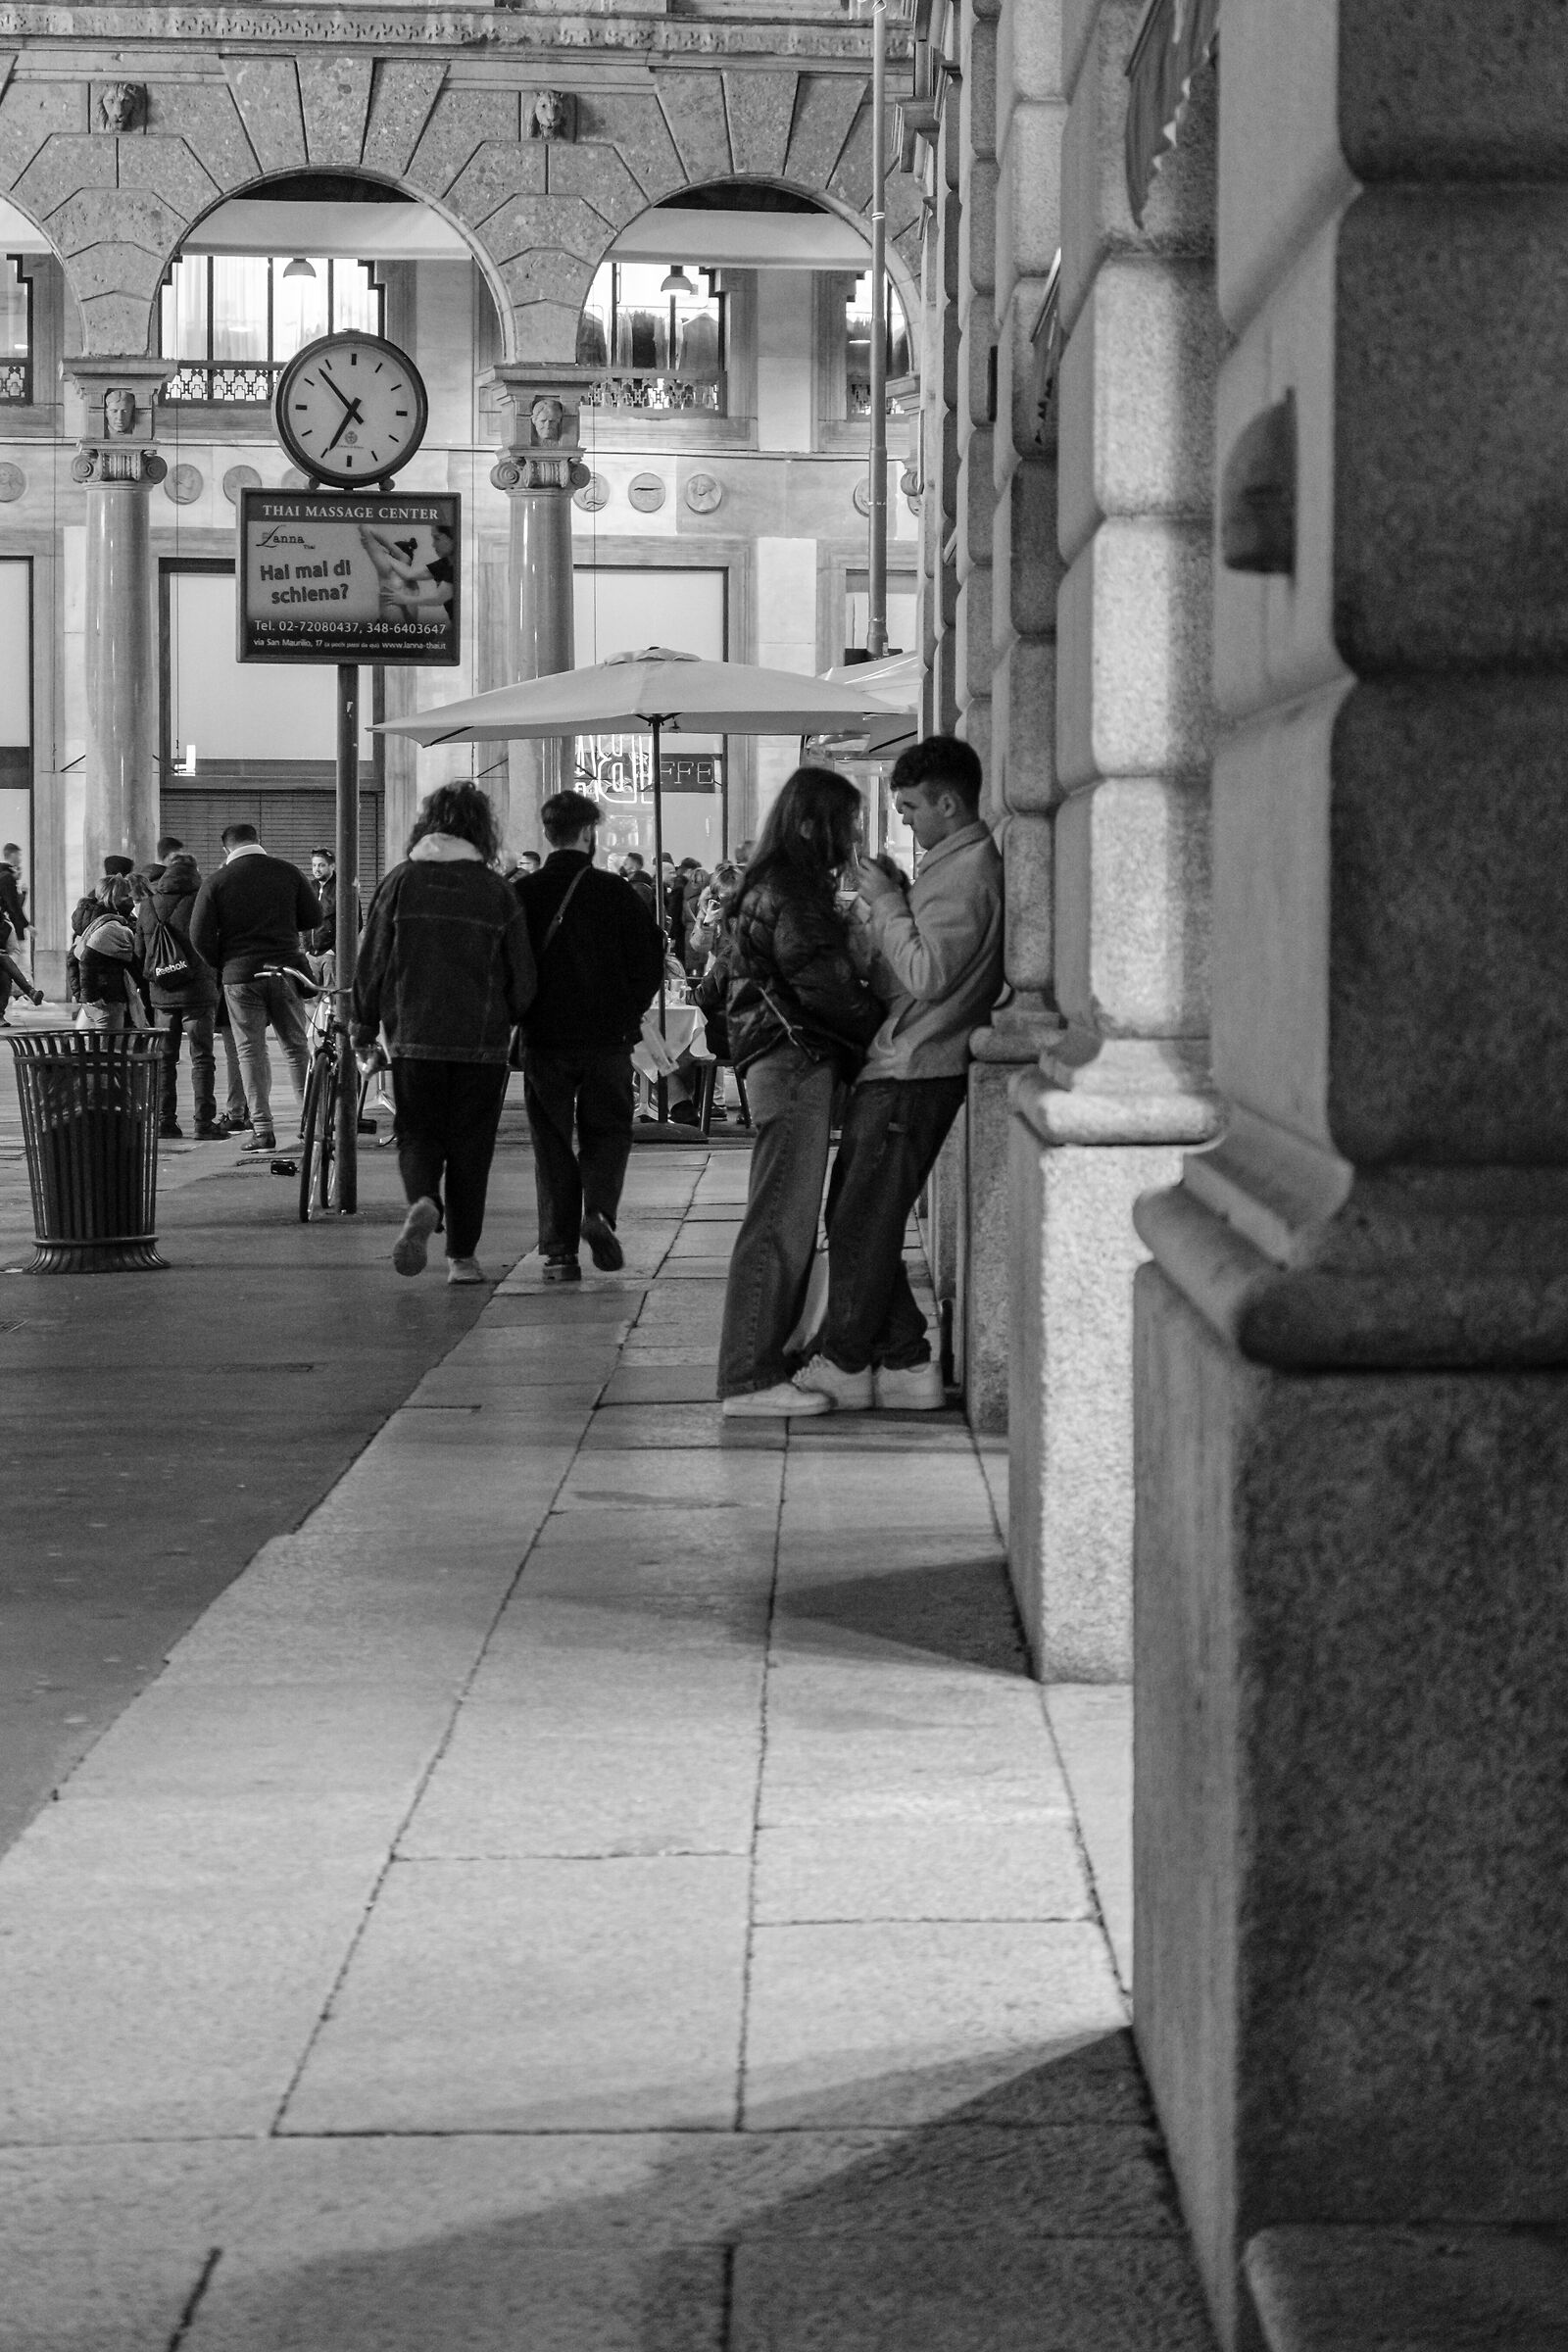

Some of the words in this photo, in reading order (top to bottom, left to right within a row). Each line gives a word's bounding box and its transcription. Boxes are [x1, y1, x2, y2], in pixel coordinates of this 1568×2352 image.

[263, 505, 300, 516] THAI
[306, 506, 373, 518] MASSAGE
[378, 507, 439, 519] CENTER
[260, 564, 290, 581] Hai
[295, 560, 328, 579] mal
[333, 559, 351, 576] di
[271, 583, 349, 605] schiena?
[255, 619, 275, 631] Tel.
[278, 620, 363, 634] 02-72080437,
[367, 622, 446, 635] 348-6403647
[267, 638, 280, 647] San
[156, 960, 187, 977] Reebok
